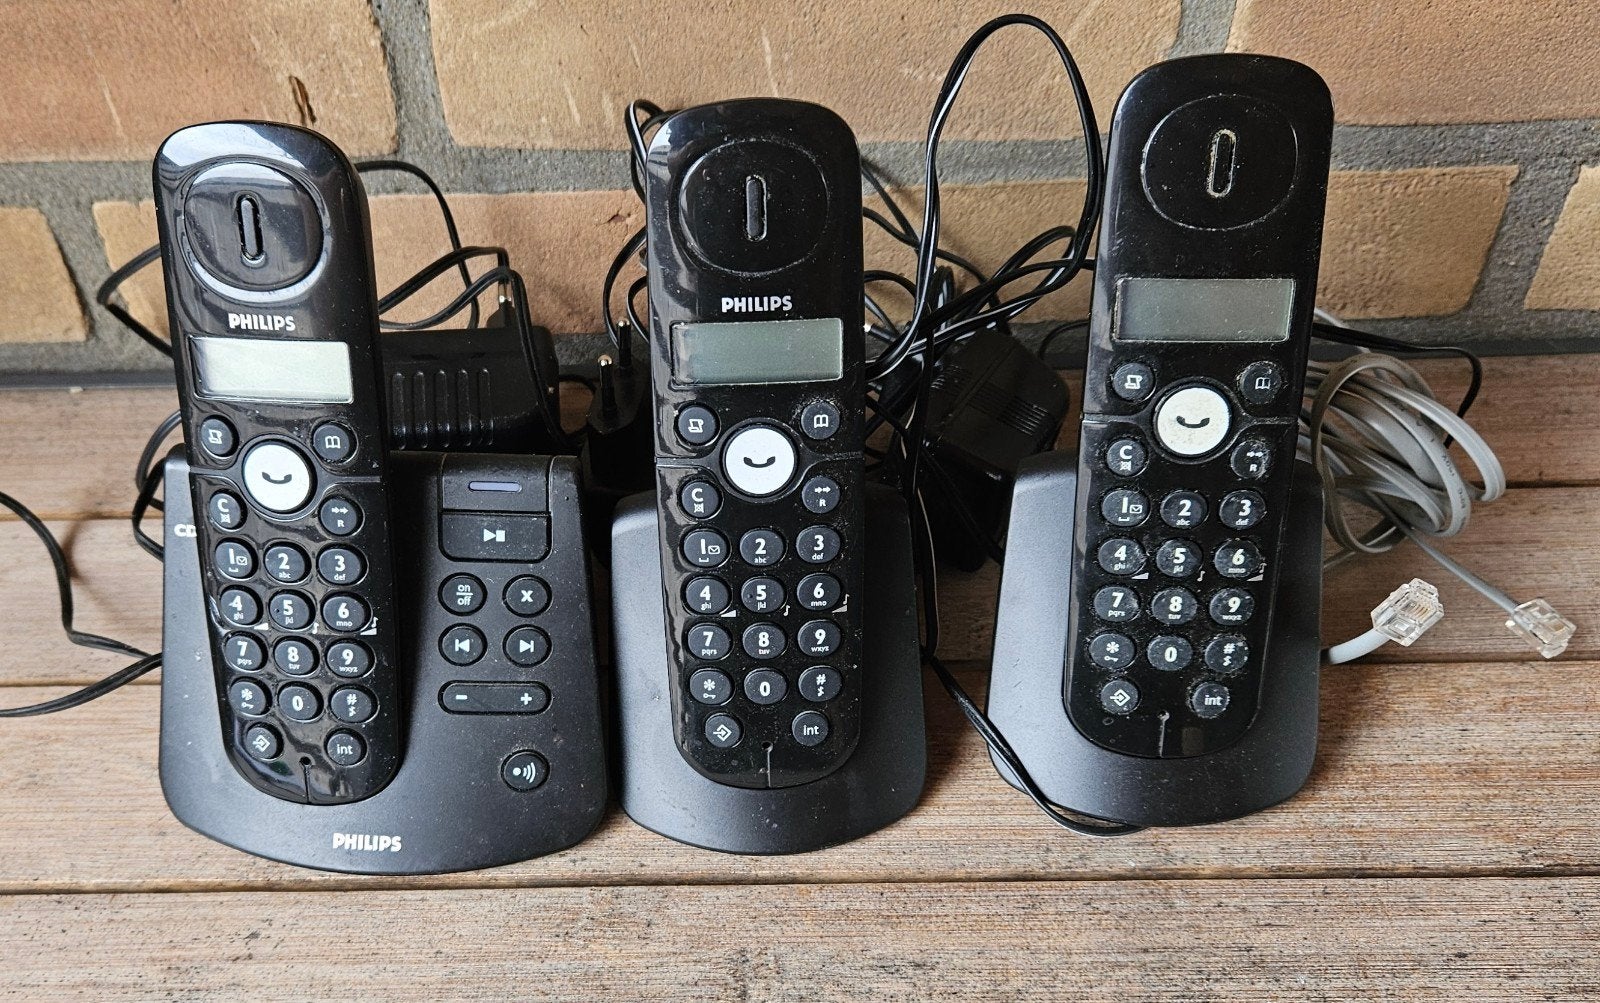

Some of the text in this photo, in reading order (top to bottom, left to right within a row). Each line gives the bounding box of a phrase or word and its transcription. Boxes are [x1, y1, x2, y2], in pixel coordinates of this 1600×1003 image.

[722, 296, 792, 312] PHILIPS
[229, 313, 295, 331] PHILIPS
[1120, 445, 1132, 459] C
[1249, 463, 1258, 472] R
[692, 488, 703, 502] C
[218, 499, 229, 512] C
[819, 498, 827, 507] R
[1179, 500, 1191, 516] 2
[1239, 500, 1251, 516] 3
[337, 519, 345, 528] R
[1175, 518, 1191, 526] abc
[1235, 518, 1250, 526] def
[756, 538, 766, 554] 2
[814, 535, 824, 550] 3
[754, 556, 767, 564] abc
[811, 552, 824, 561] def
[1115, 546, 1126, 560] 4
[1173, 548, 1186, 563] 5
[1231, 549, 1244, 565] 6
[278, 553, 289, 569] 2
[335, 555, 345, 571] 3
[1113, 562, 1126, 571] ghi
[278, 571, 292, 579] abc
[333, 573, 346, 581] def
[457, 584, 471, 593] on
[700, 586, 710, 600] 4
[756, 585, 766, 600] 5
[814, 583, 824, 598] 6
[229, 596, 242, 611] 4
[457, 595, 472, 606] off
[700, 601, 712, 611] ghi
[1112, 592, 1124, 607] 7
[1169, 596, 1182, 612] 8
[1228, 597, 1240, 612] 9
[283, 600, 293, 615] 5
[338, 603, 349, 618] 6
[1107, 609, 1126, 618] pqrs
[233, 611, 244, 621] ghi
[703, 632, 713, 646] 7
[759, 632, 769, 647] 8
[815, 629, 826, 644] 9
[238, 641, 247, 656] 7
[288, 647, 299, 662] 8
[701, 648, 718, 657] pqrs
[810, 645, 830, 653] wxyz
[1165, 647, 1177, 662] 0
[236, 657, 253, 666] pqrs
[342, 649, 353, 665] 9
[338, 666, 359, 674] wxyz
[760, 682, 770, 696] 0
[293, 696, 303, 711] 0
[1204, 694, 1223, 706] int
[803, 724, 820, 736] int
[336, 743, 354, 755] int
[333, 833, 401, 851] PHILIPS
